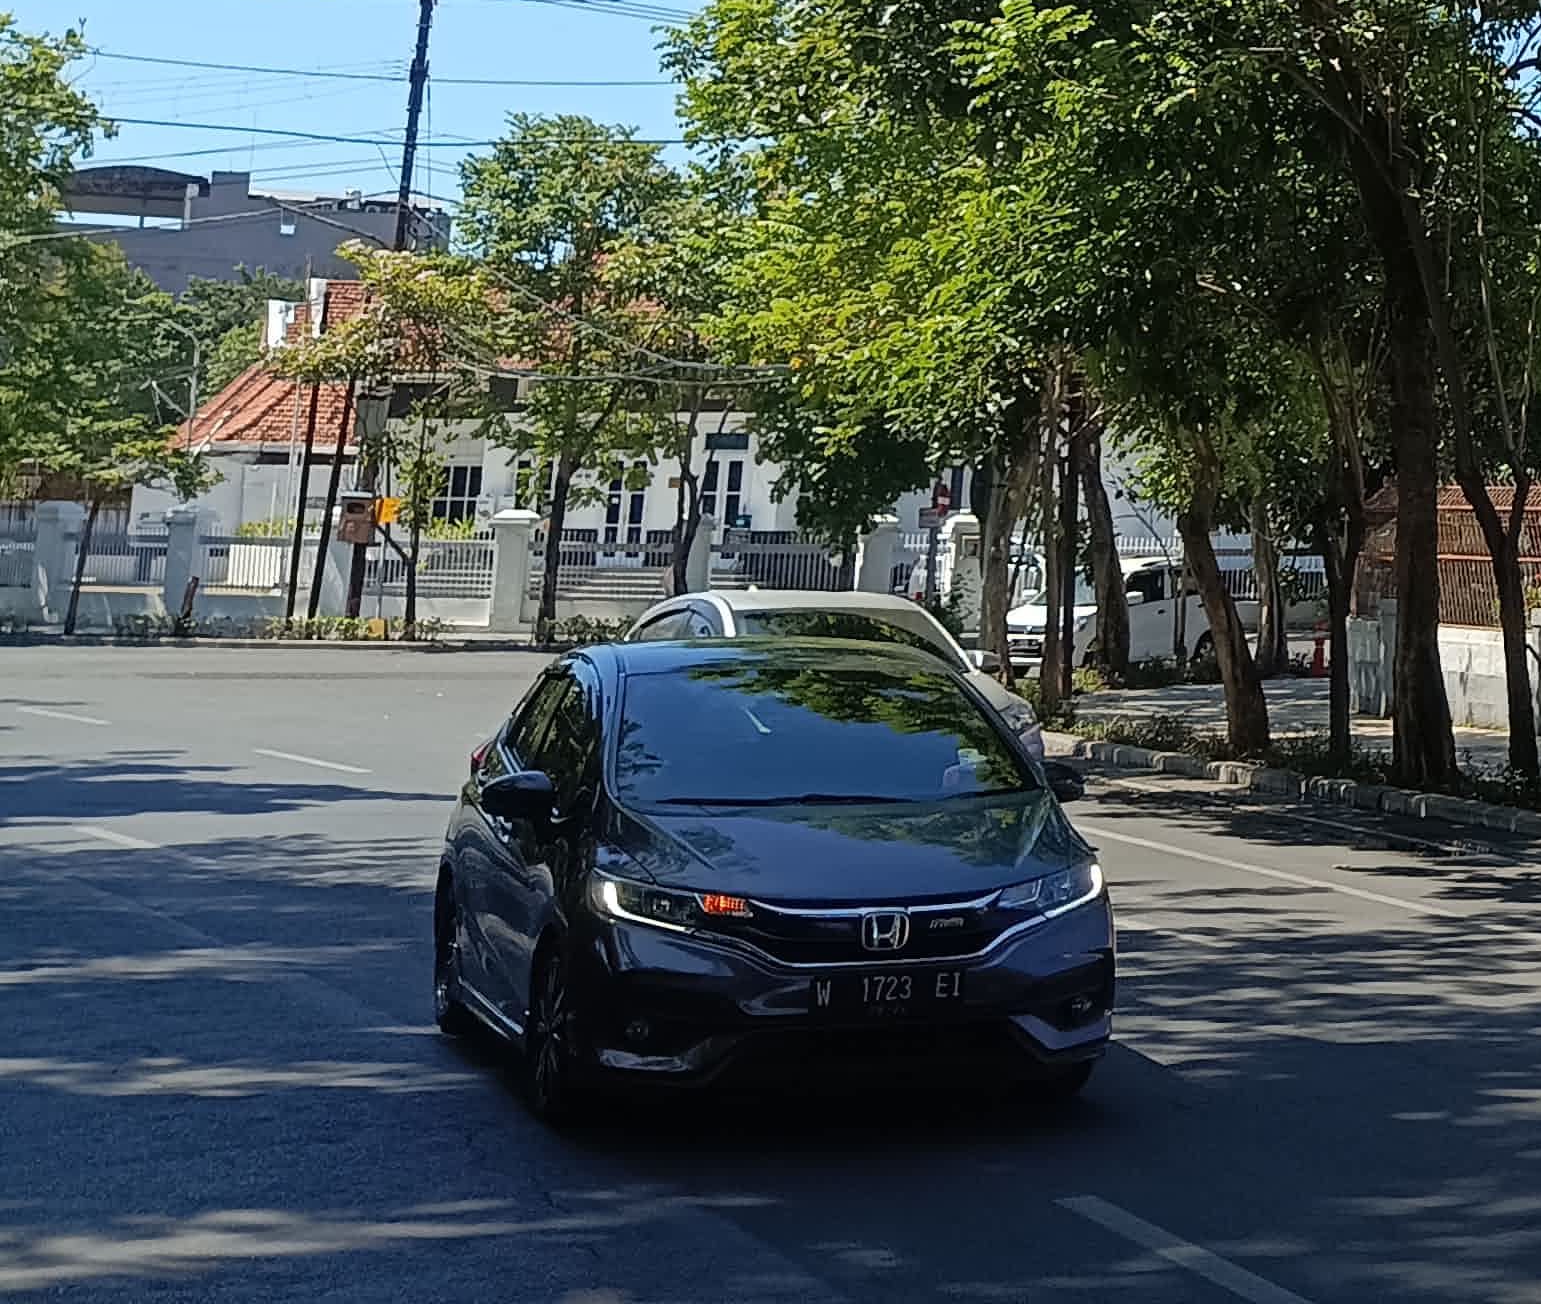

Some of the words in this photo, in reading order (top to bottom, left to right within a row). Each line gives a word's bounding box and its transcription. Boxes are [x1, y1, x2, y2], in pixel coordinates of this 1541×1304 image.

[816, 980, 831, 1007] W
[863, 975, 912, 1003] 1723
[936, 972, 960, 998] EI
